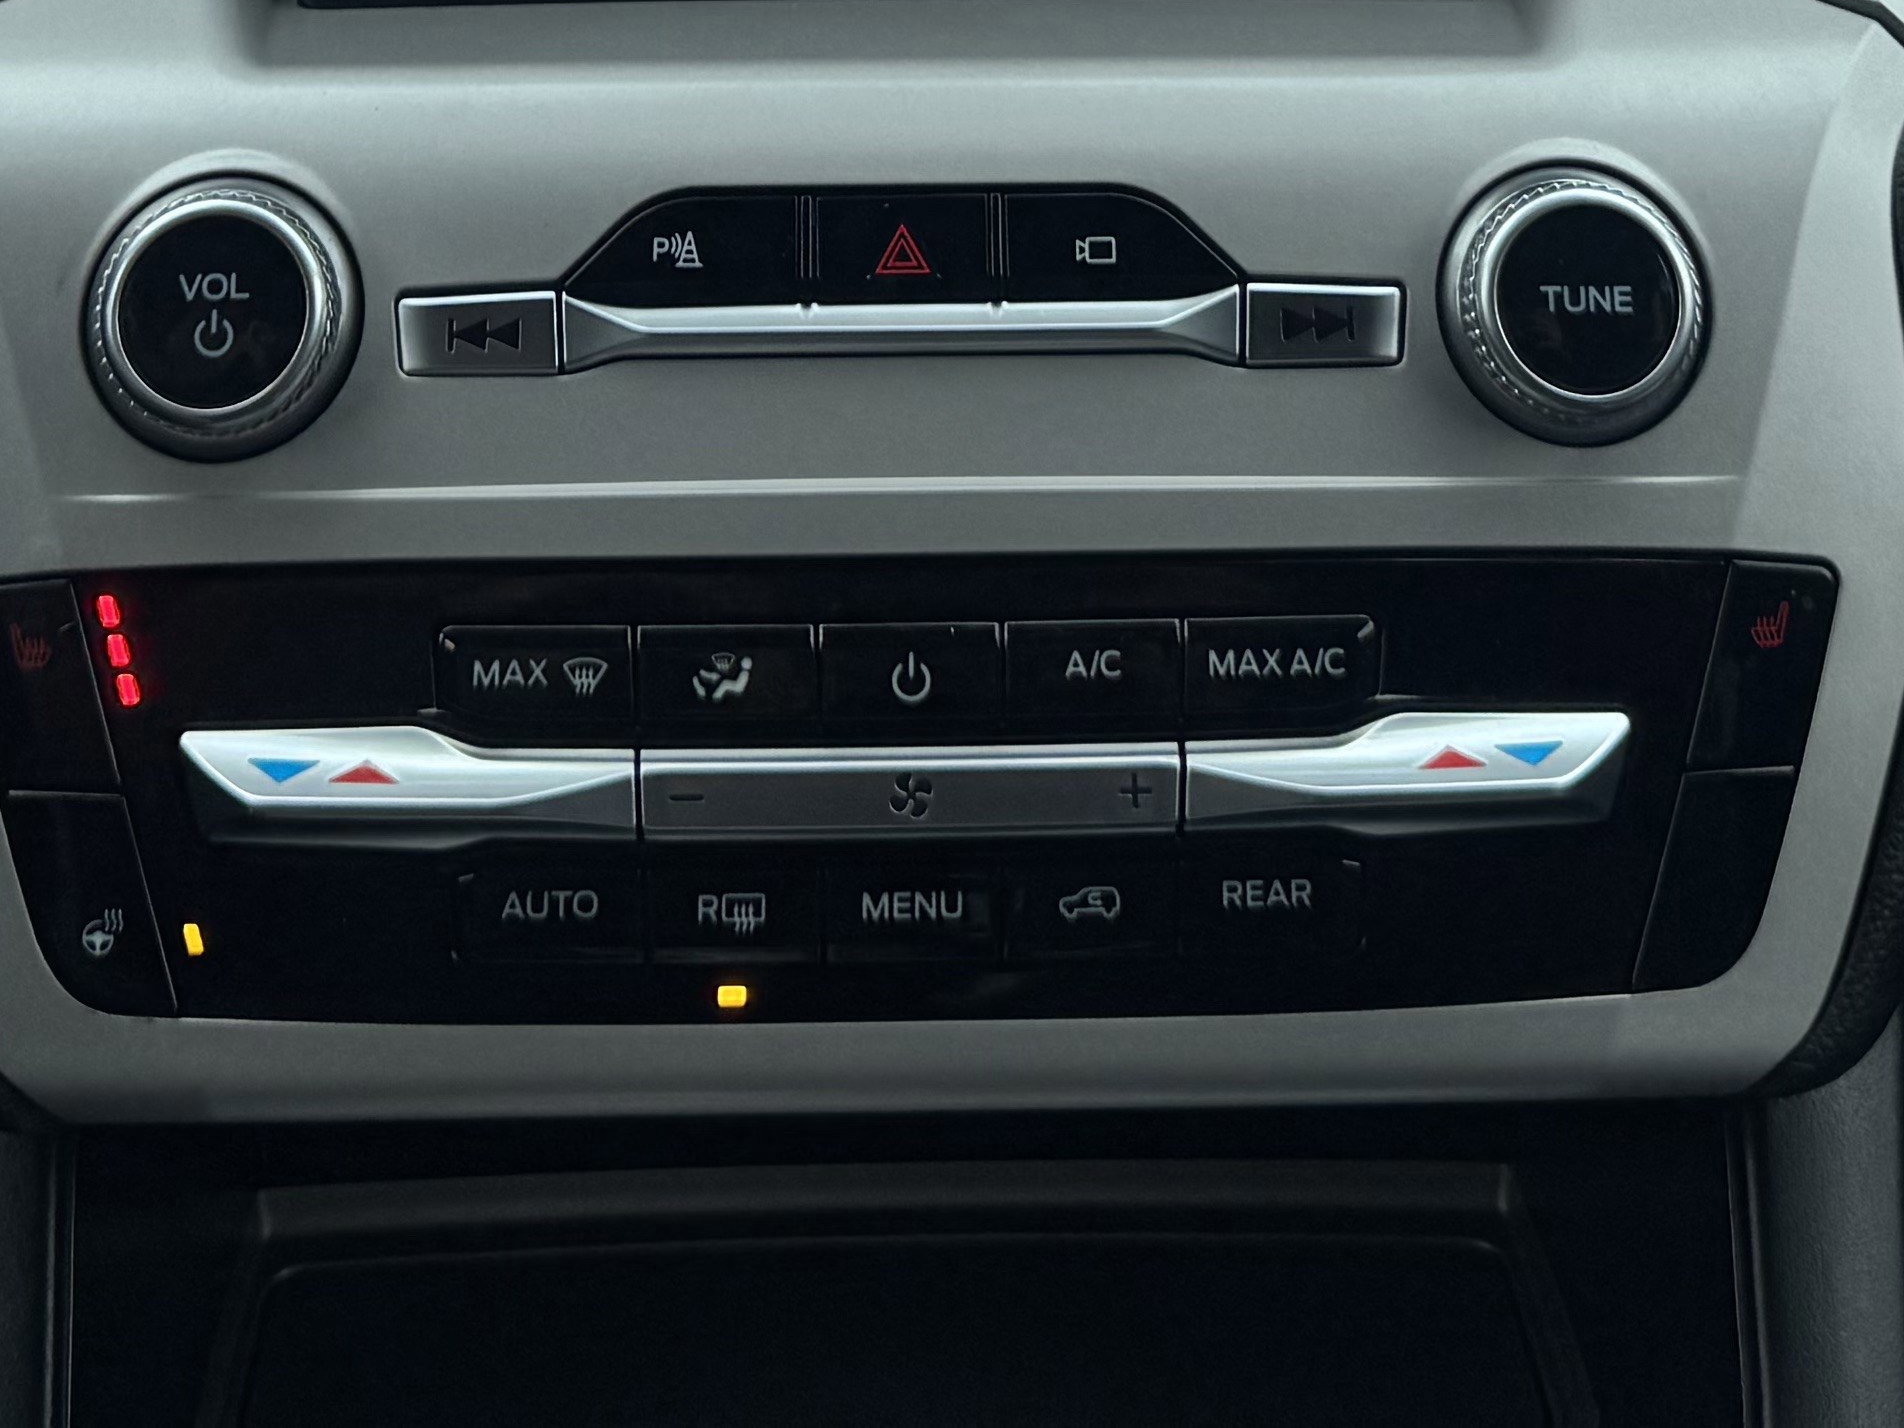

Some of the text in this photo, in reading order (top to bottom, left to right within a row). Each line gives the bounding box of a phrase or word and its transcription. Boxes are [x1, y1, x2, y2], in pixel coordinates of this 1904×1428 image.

[179, 272, 250, 302] VOL
[1539, 285, 1634, 313] TUNE
[472, 658, 548, 688] MAX
[1065, 649, 1122, 678] A/C
[1208, 647, 1346, 677] MAX A/C
[501, 889, 599, 919] AUTO
[861, 890, 963, 921] MENU
[1222, 878, 1312, 909] REAR
